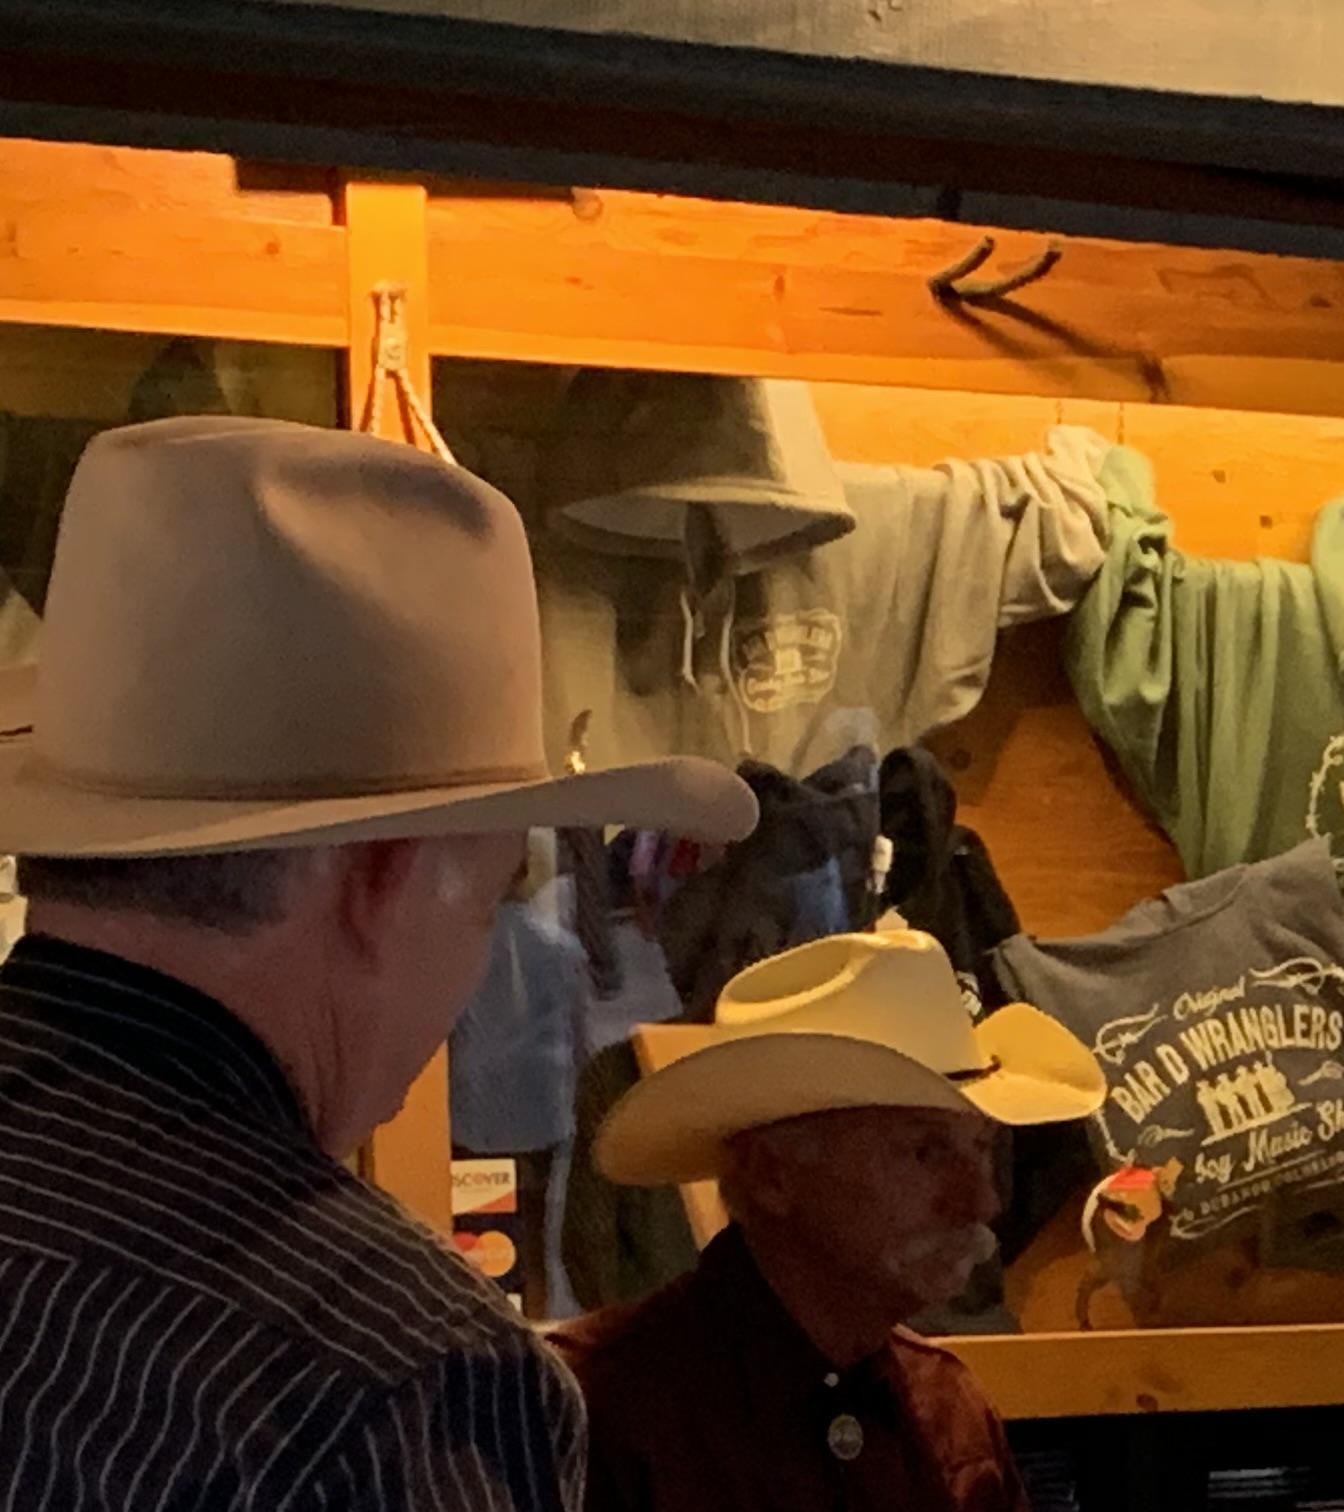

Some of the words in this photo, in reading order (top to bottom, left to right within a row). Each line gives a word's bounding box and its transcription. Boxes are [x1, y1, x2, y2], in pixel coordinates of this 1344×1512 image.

[1110, 1059, 1171, 1124] BAR
[1156, 1043, 1190, 1085] D
[1180, 1003, 1343, 1071] WRANGLERS
[1244, 1121, 1313, 1172] Music
